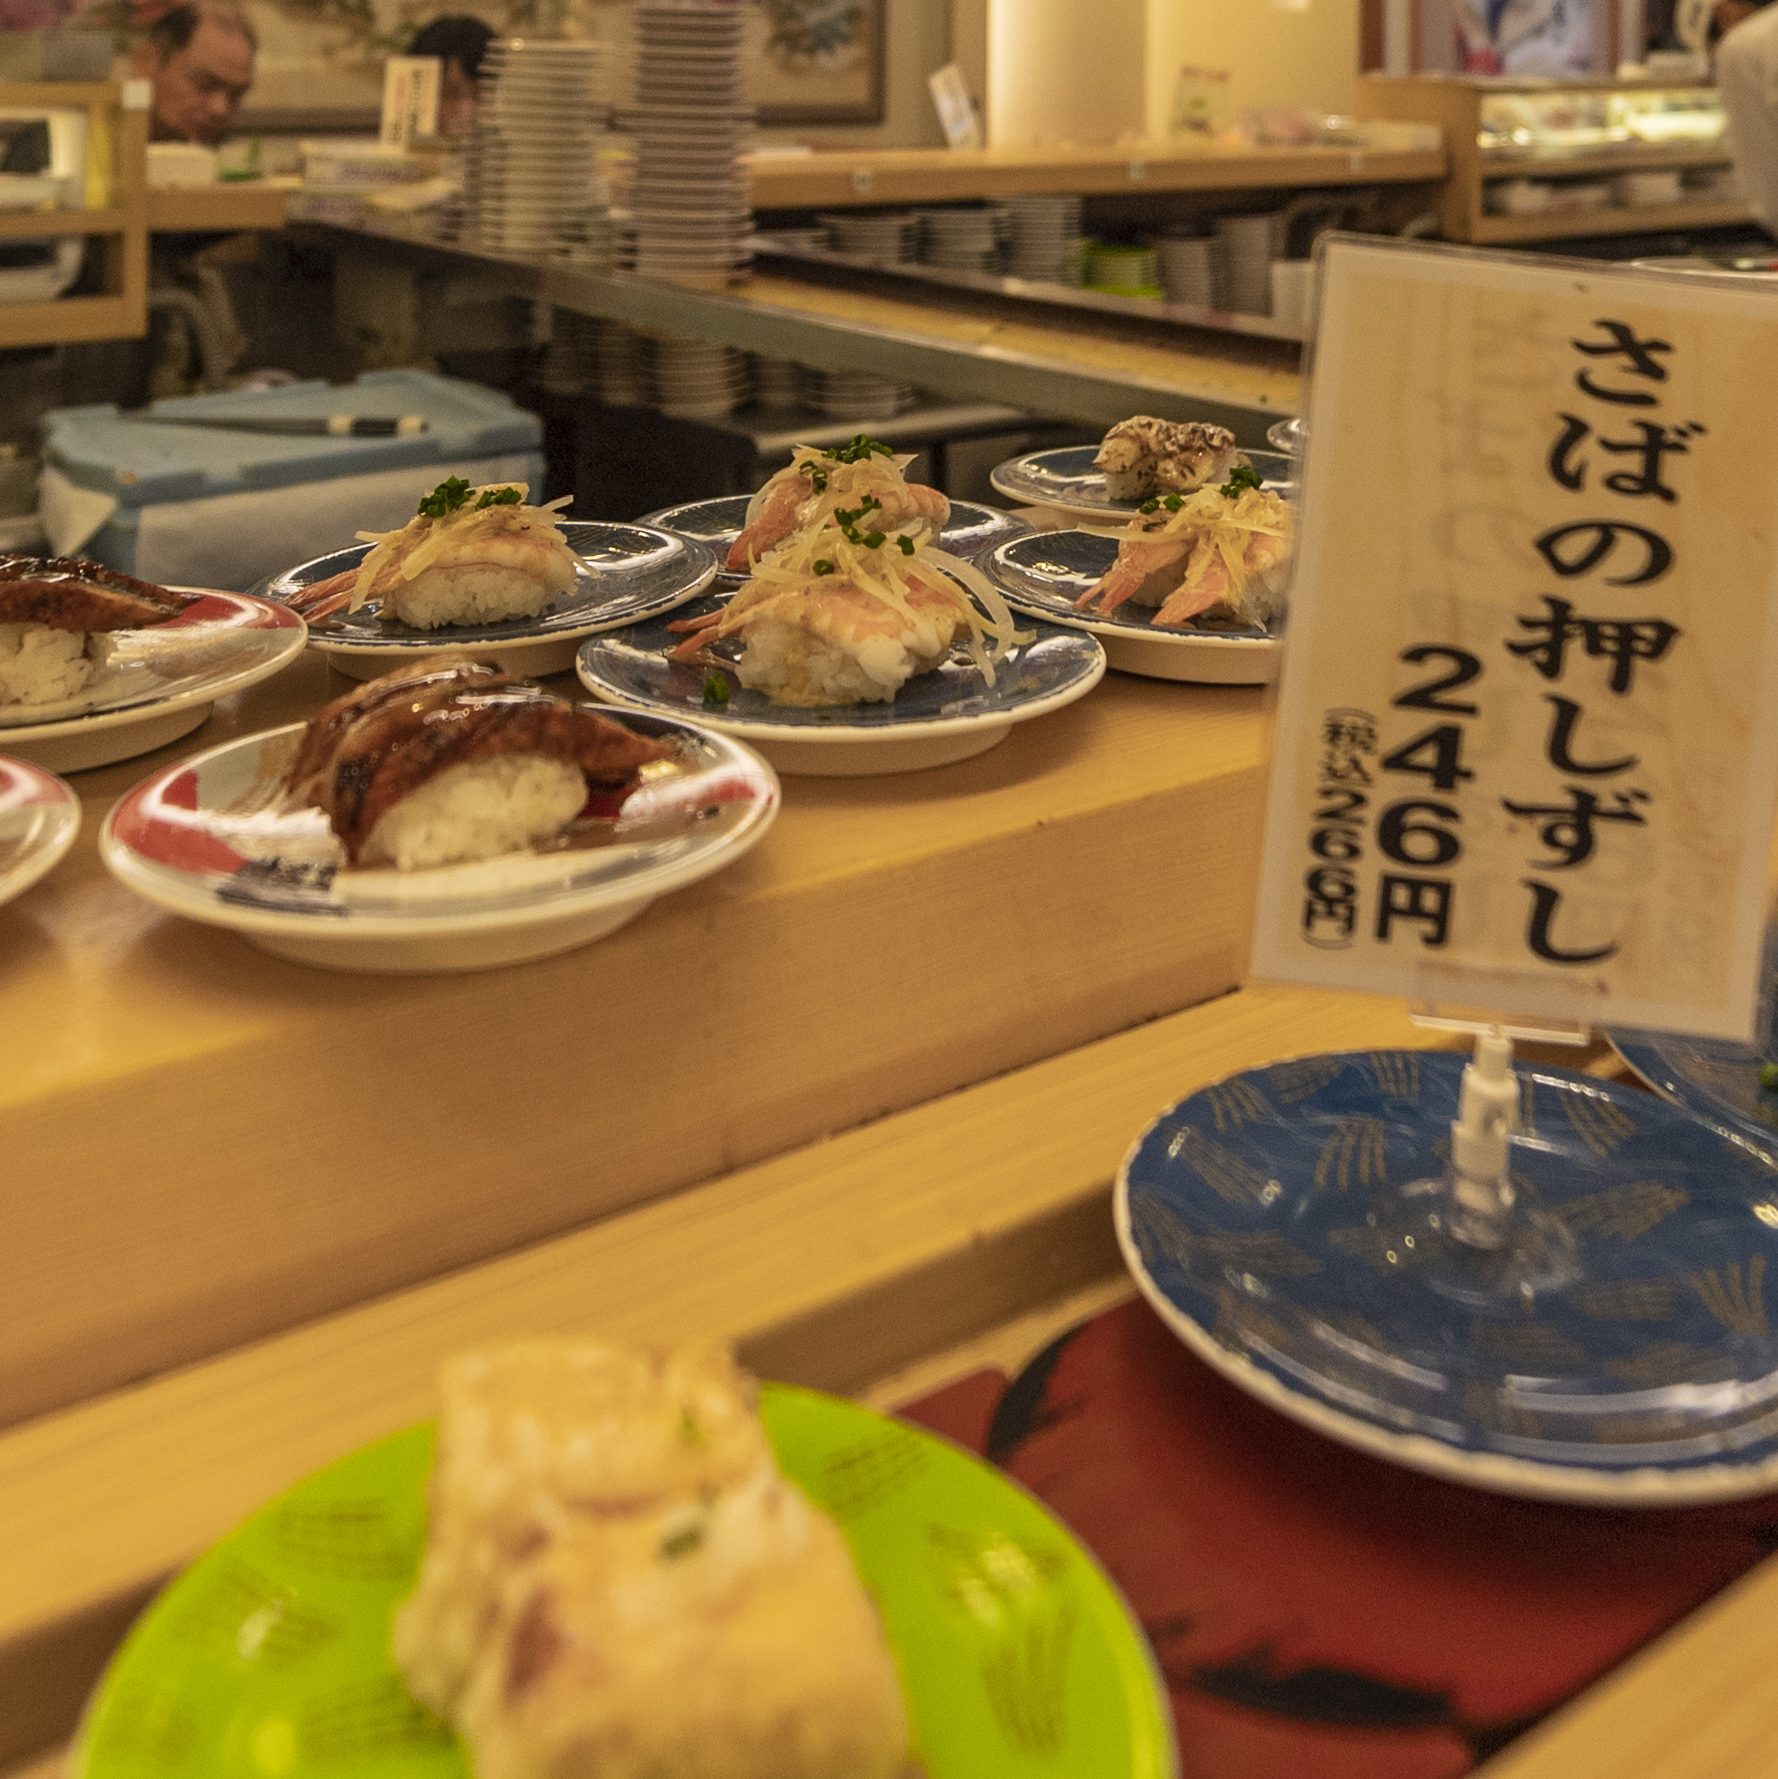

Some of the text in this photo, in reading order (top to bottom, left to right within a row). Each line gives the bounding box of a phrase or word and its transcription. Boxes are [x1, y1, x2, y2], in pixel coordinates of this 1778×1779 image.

[1374, 642, 1483, 947] 246円
[1503, 319, 1708, 966] さばの押しずし
